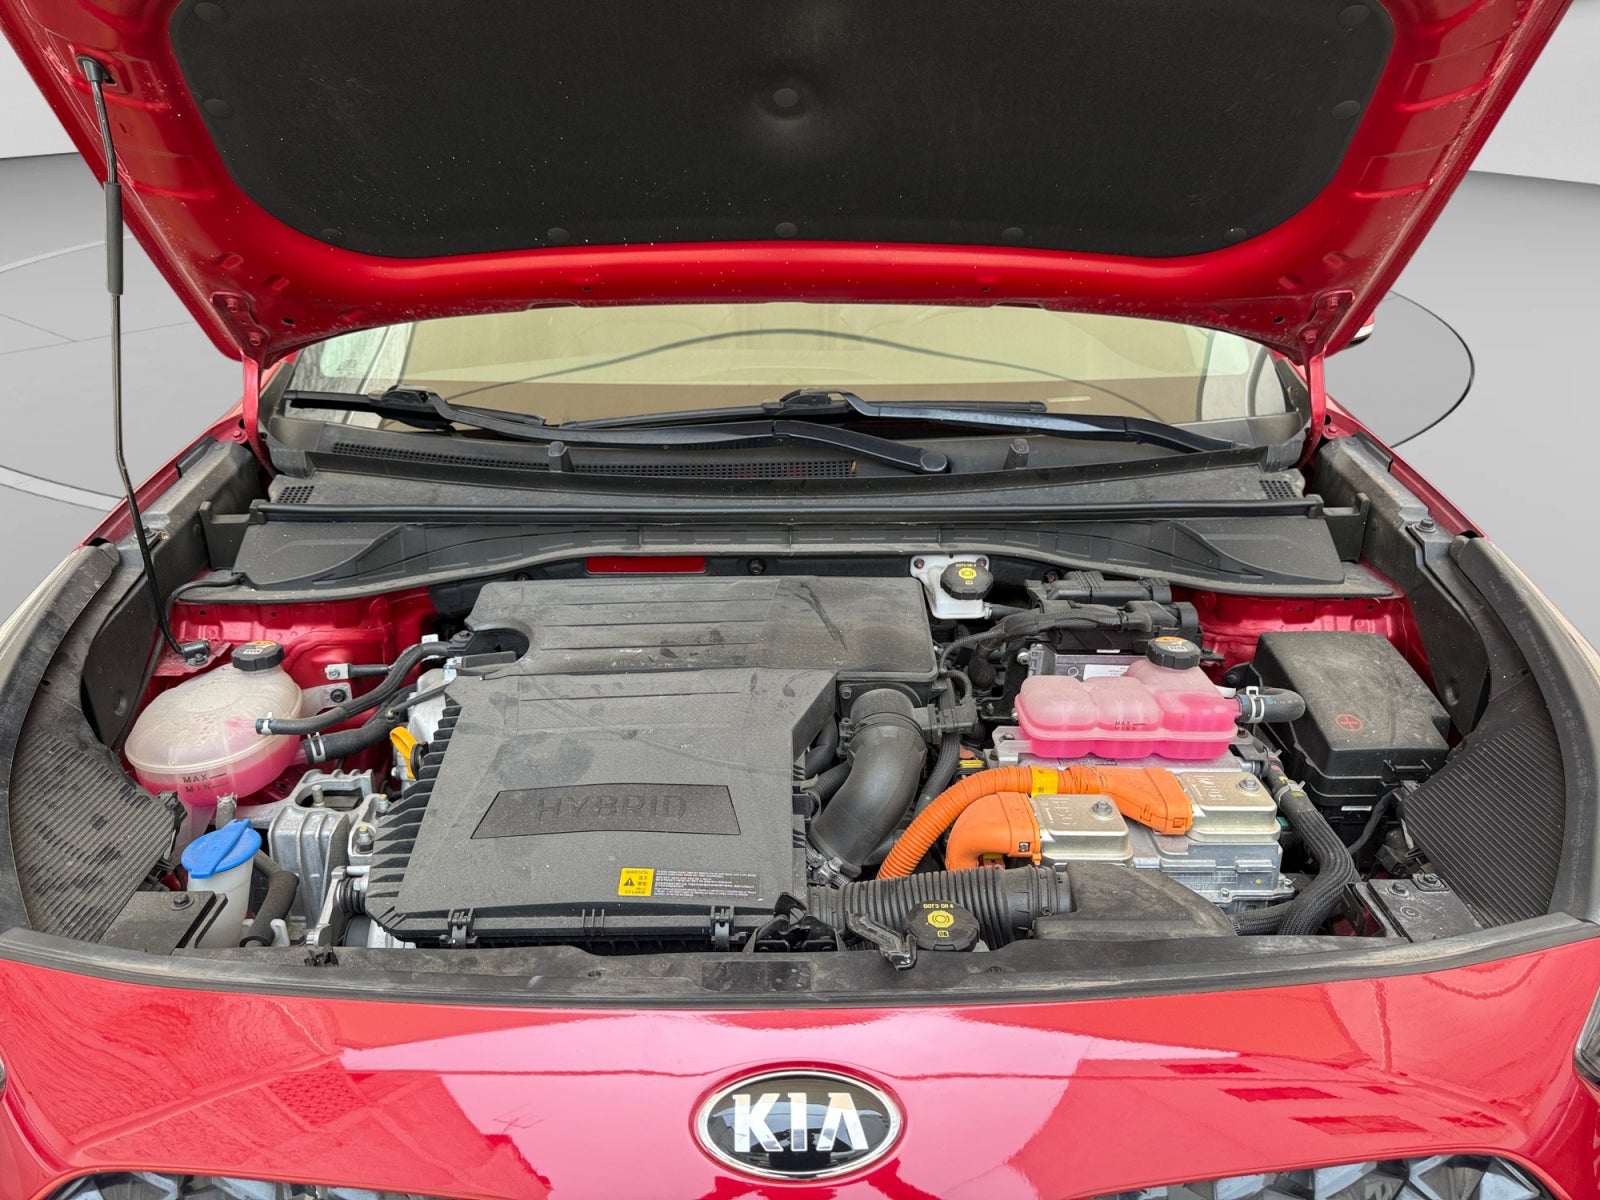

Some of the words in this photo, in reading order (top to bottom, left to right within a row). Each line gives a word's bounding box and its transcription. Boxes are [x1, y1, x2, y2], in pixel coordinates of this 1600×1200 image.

[182, 773, 208, 784] MAX
[185, 783, 211, 793] MIN
[536, 795, 687, 821] HYBRID
[732, 1092, 869, 1152] KIA
